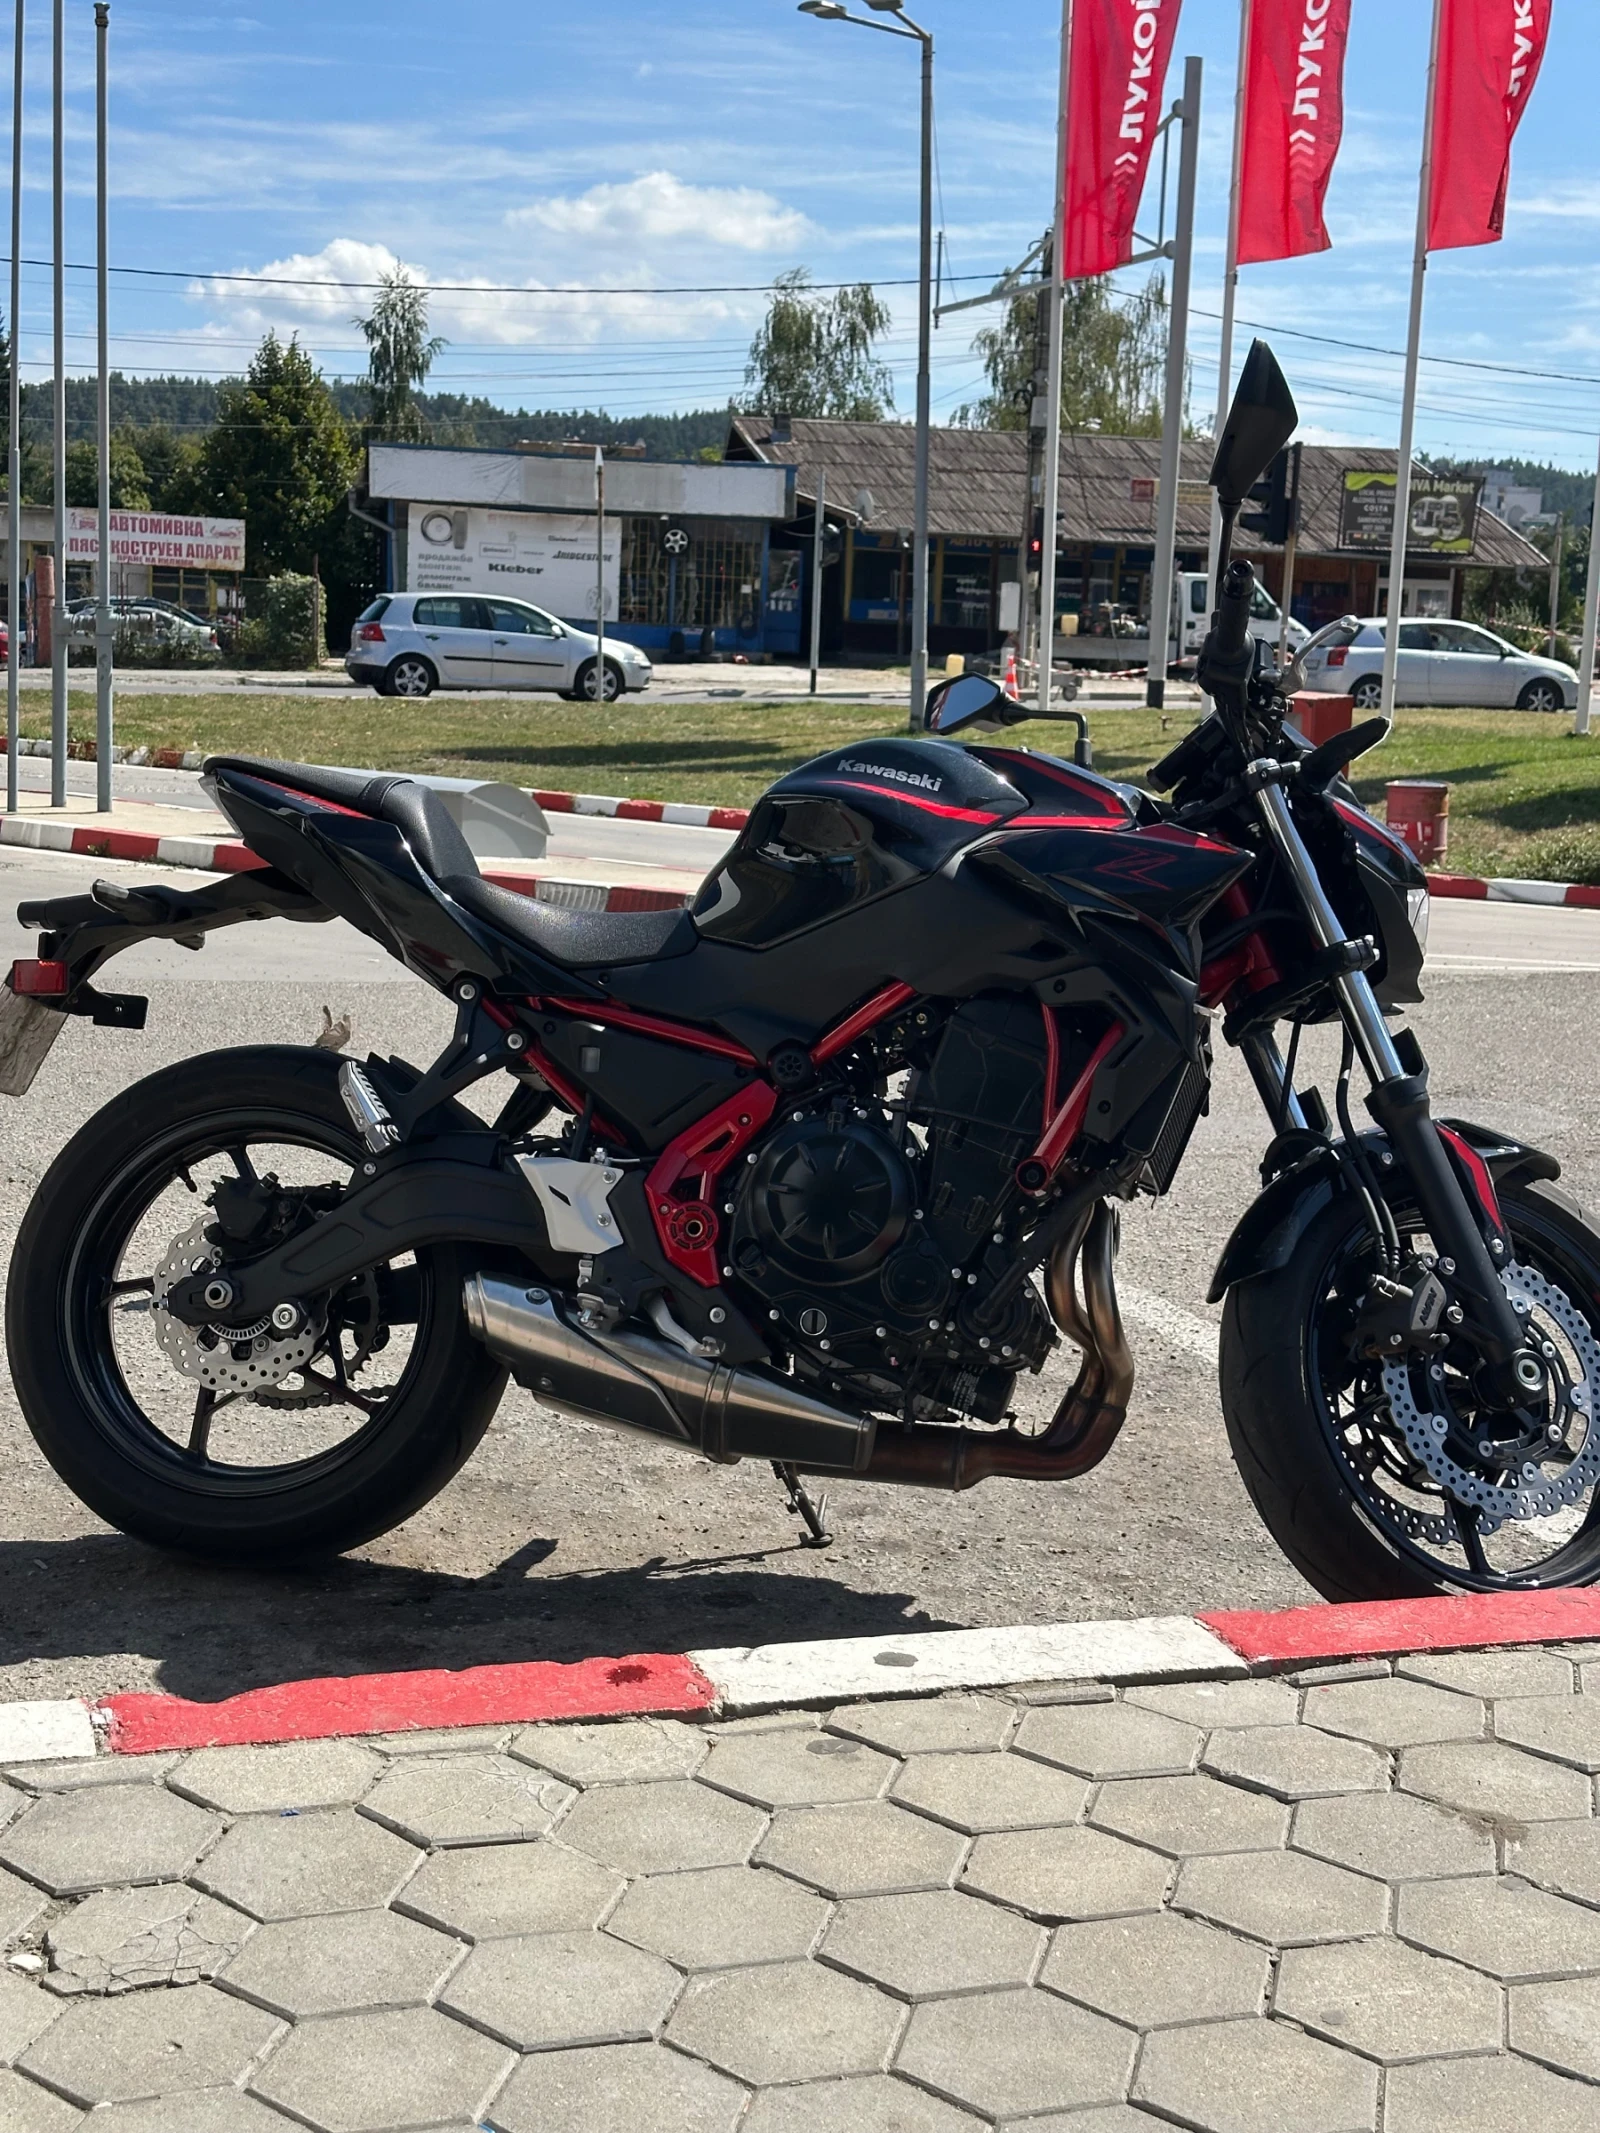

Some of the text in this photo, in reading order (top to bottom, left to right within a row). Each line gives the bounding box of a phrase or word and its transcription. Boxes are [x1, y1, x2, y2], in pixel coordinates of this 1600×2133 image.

[1410, 479, 1475, 495] IVA Market
[1363, 504, 1388, 512] COSTA
[109, 515, 204, 537] АВТОМИВКА
[70, 538, 241, 560] ПЯСКОСТРУЕН АПАРАТ
[488, 563, 544, 575] Kleber
[837, 759, 942, 792] Kawasaki
